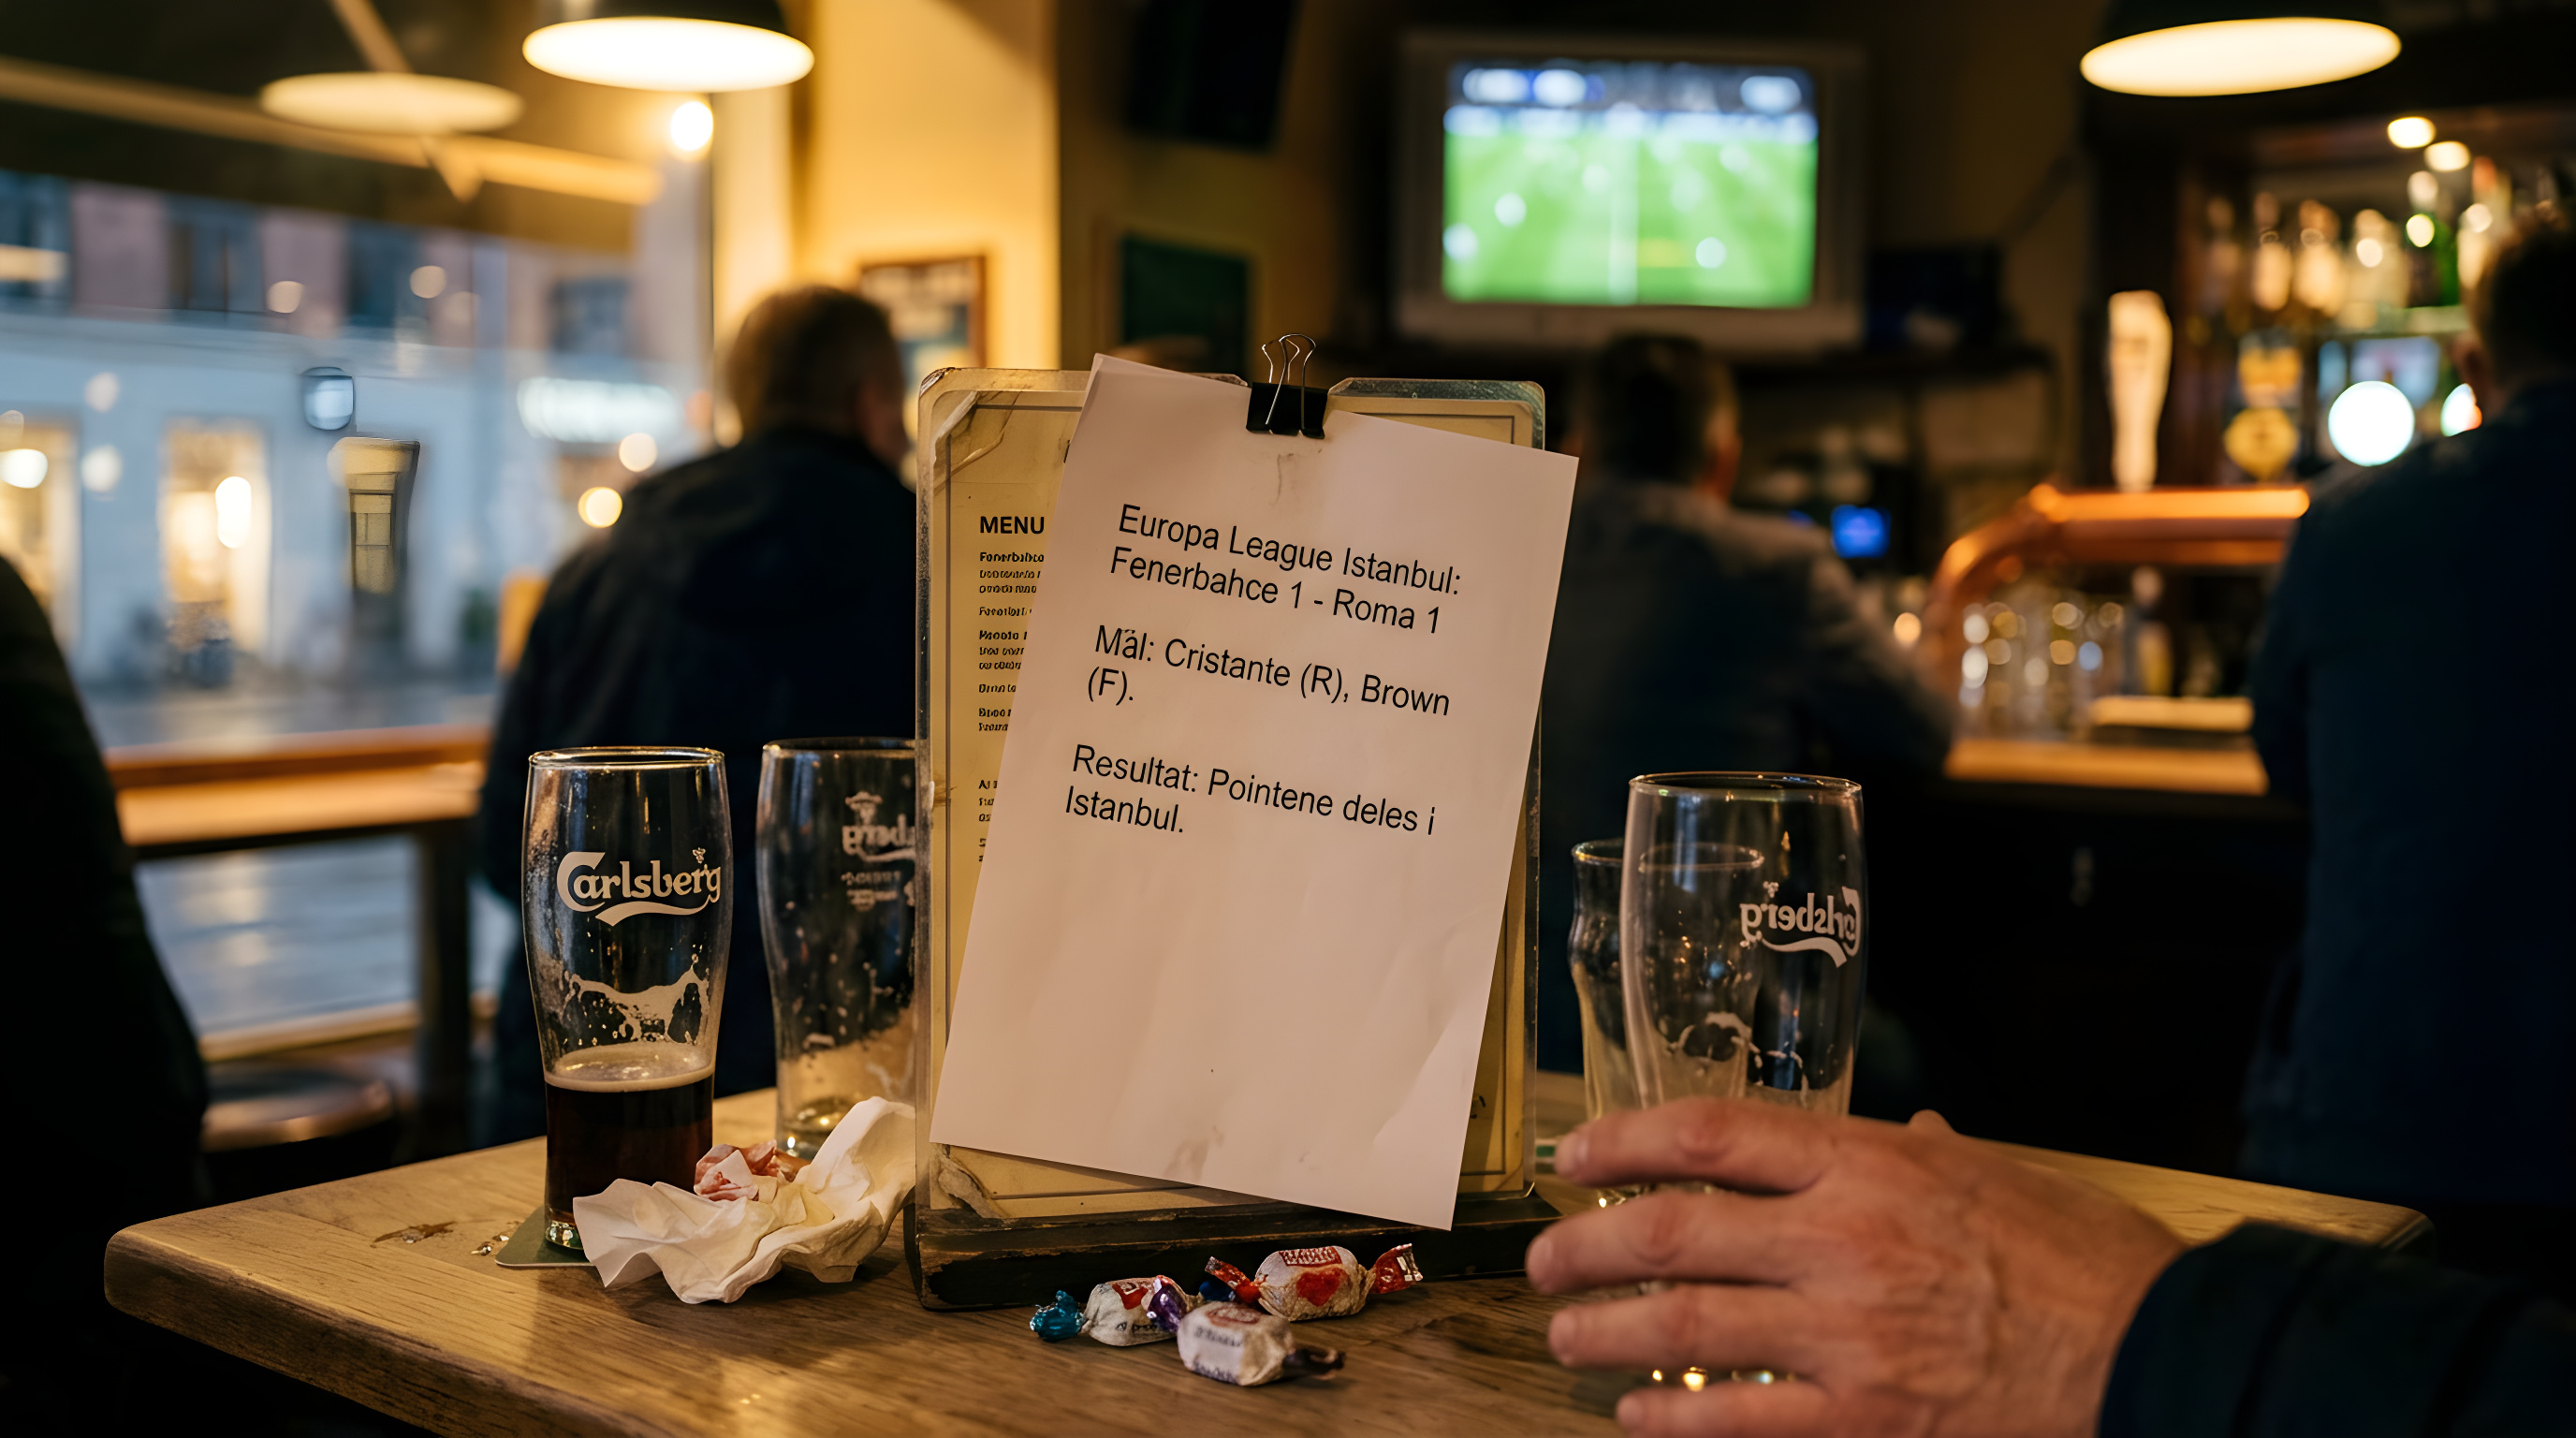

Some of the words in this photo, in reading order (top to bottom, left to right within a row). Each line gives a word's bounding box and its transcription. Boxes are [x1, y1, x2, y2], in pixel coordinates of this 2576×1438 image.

[979, 515, 1046, 535] MENU
[1119, 503, 1220, 550] Europa
[1229, 525, 1333, 572] League
[1342, 547, 1460, 595] Istanbul:
[1110, 546, 1279, 604] Fenerbahce
[1291, 580, 1302, 609] 1
[1333, 588, 1415, 630] Roma
[1427, 606, 1440, 634] 1
[1088, 666, 1134, 706] (F).
[1164, 638, 1291, 687] Cristante
[1300, 663, 1349, 704] (R),
[1360, 673, 1450, 716] Brown
[1065, 785, 1183, 833] Istanbul.
[1073, 743, 1198, 793] Resultat:
[1208, 768, 1333, 816] Pointene
[1342, 794, 1418, 831] deles
[1427, 806, 1436, 836] i
[557, 851, 721, 913] Carlsberg
